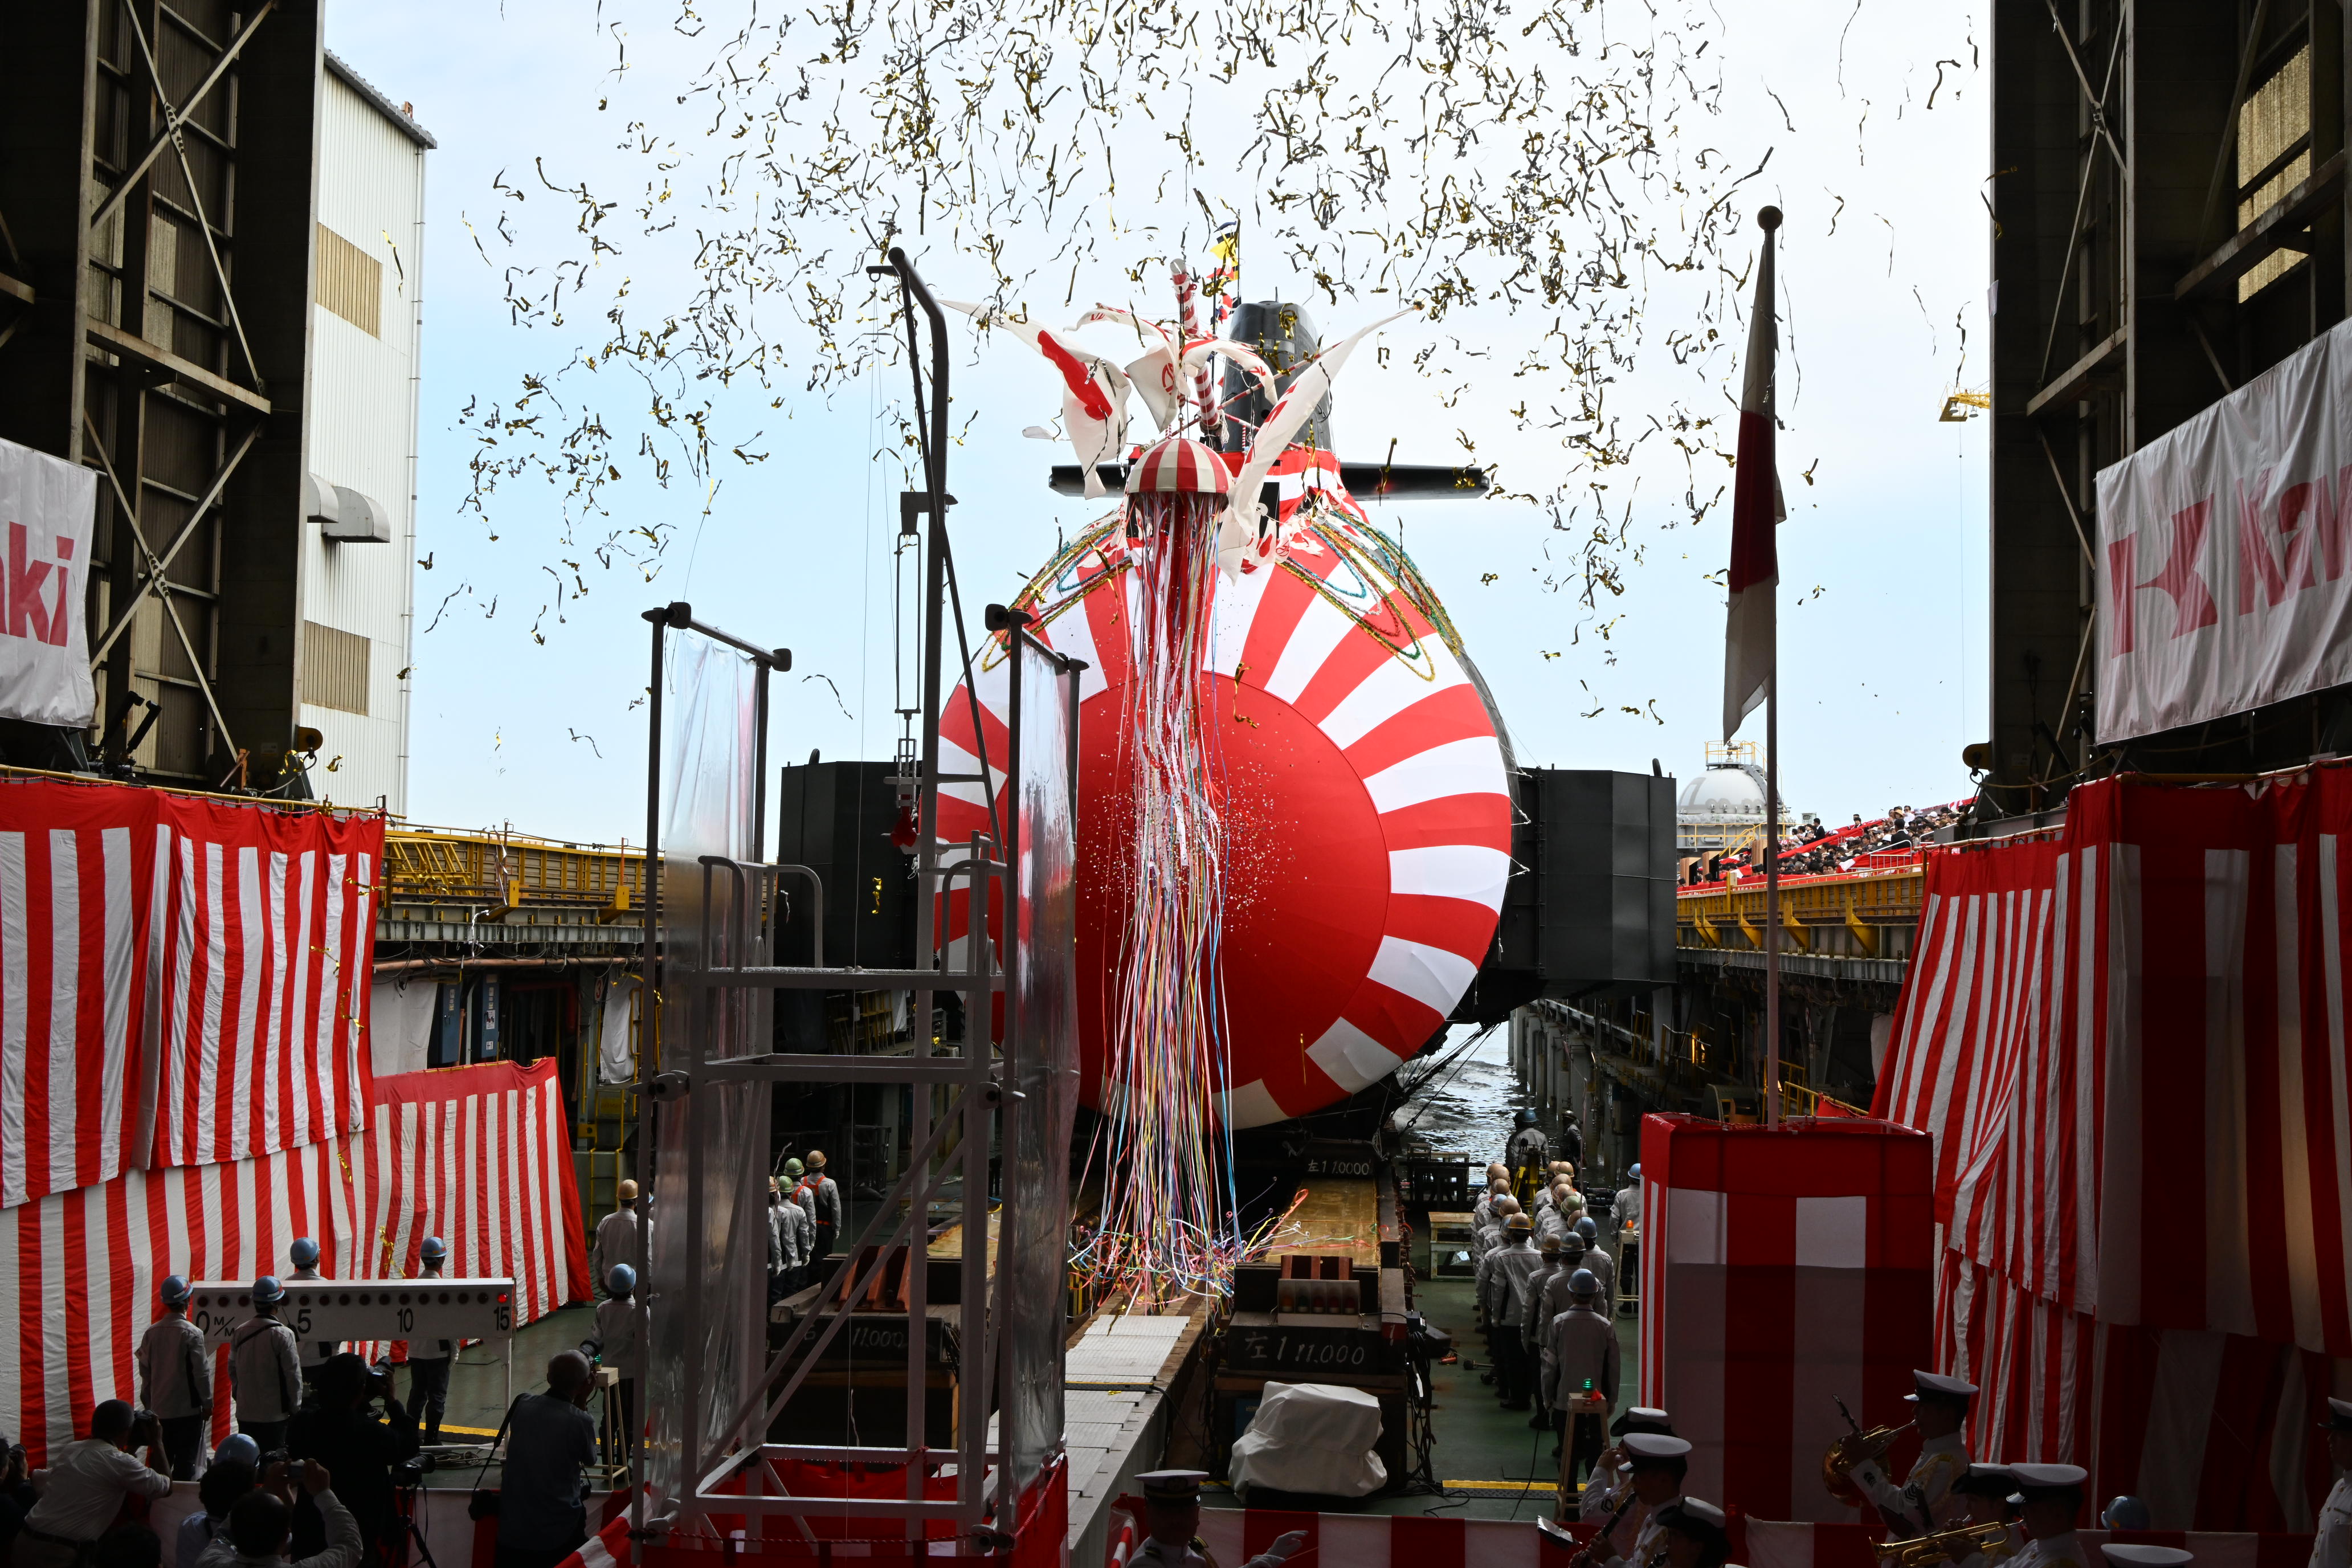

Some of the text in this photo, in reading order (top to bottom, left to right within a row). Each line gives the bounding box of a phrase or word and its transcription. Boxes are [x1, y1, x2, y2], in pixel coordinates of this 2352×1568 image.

[0, 521, 74, 647] ki
[298, 1309, 311, 1333] 5
[397, 1308, 413, 1333] 10
[494, 1306, 509, 1330] 15
